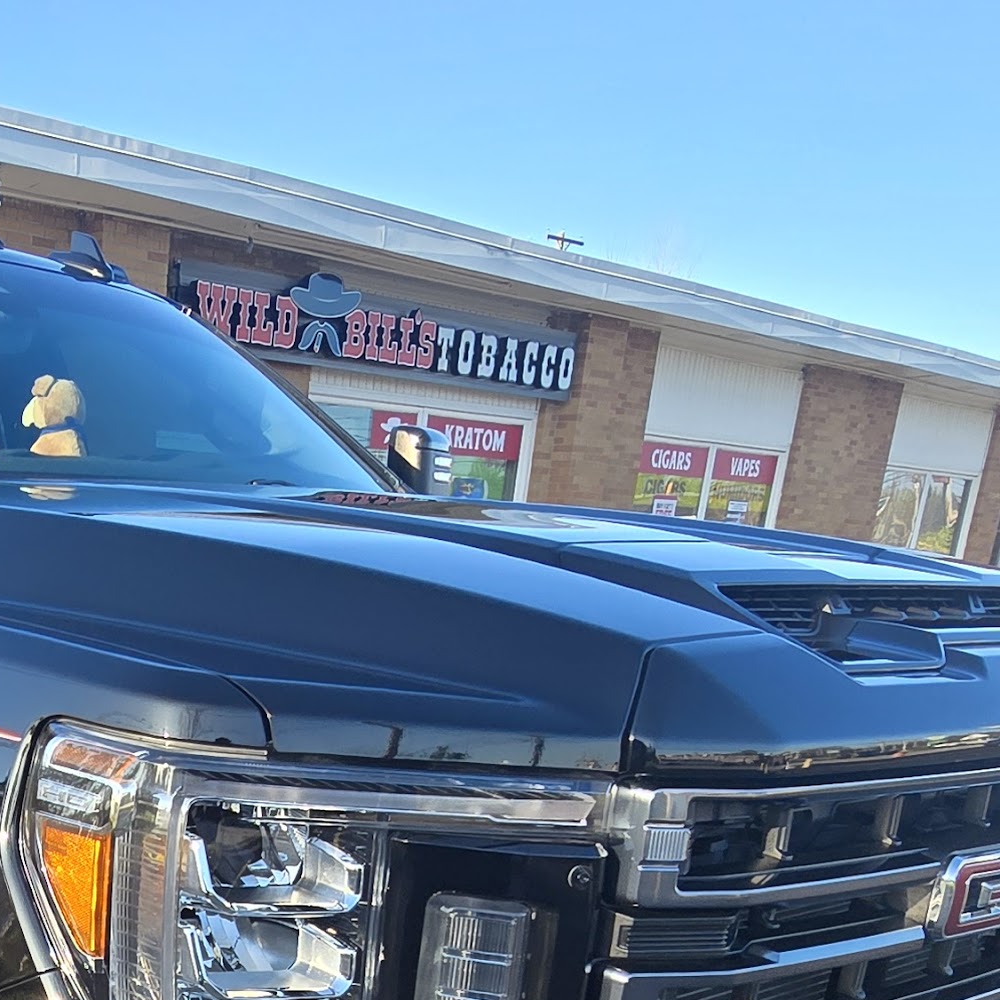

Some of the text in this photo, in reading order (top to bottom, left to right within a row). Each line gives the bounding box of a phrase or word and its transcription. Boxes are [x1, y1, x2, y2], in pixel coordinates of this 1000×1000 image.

[197, 280, 575, 391] WILD BILL'S TOBACCO
[445, 424, 507, 453] KRATOM
[651, 448, 693, 471] CIGARS
[730, 456, 761, 478] VAPES
